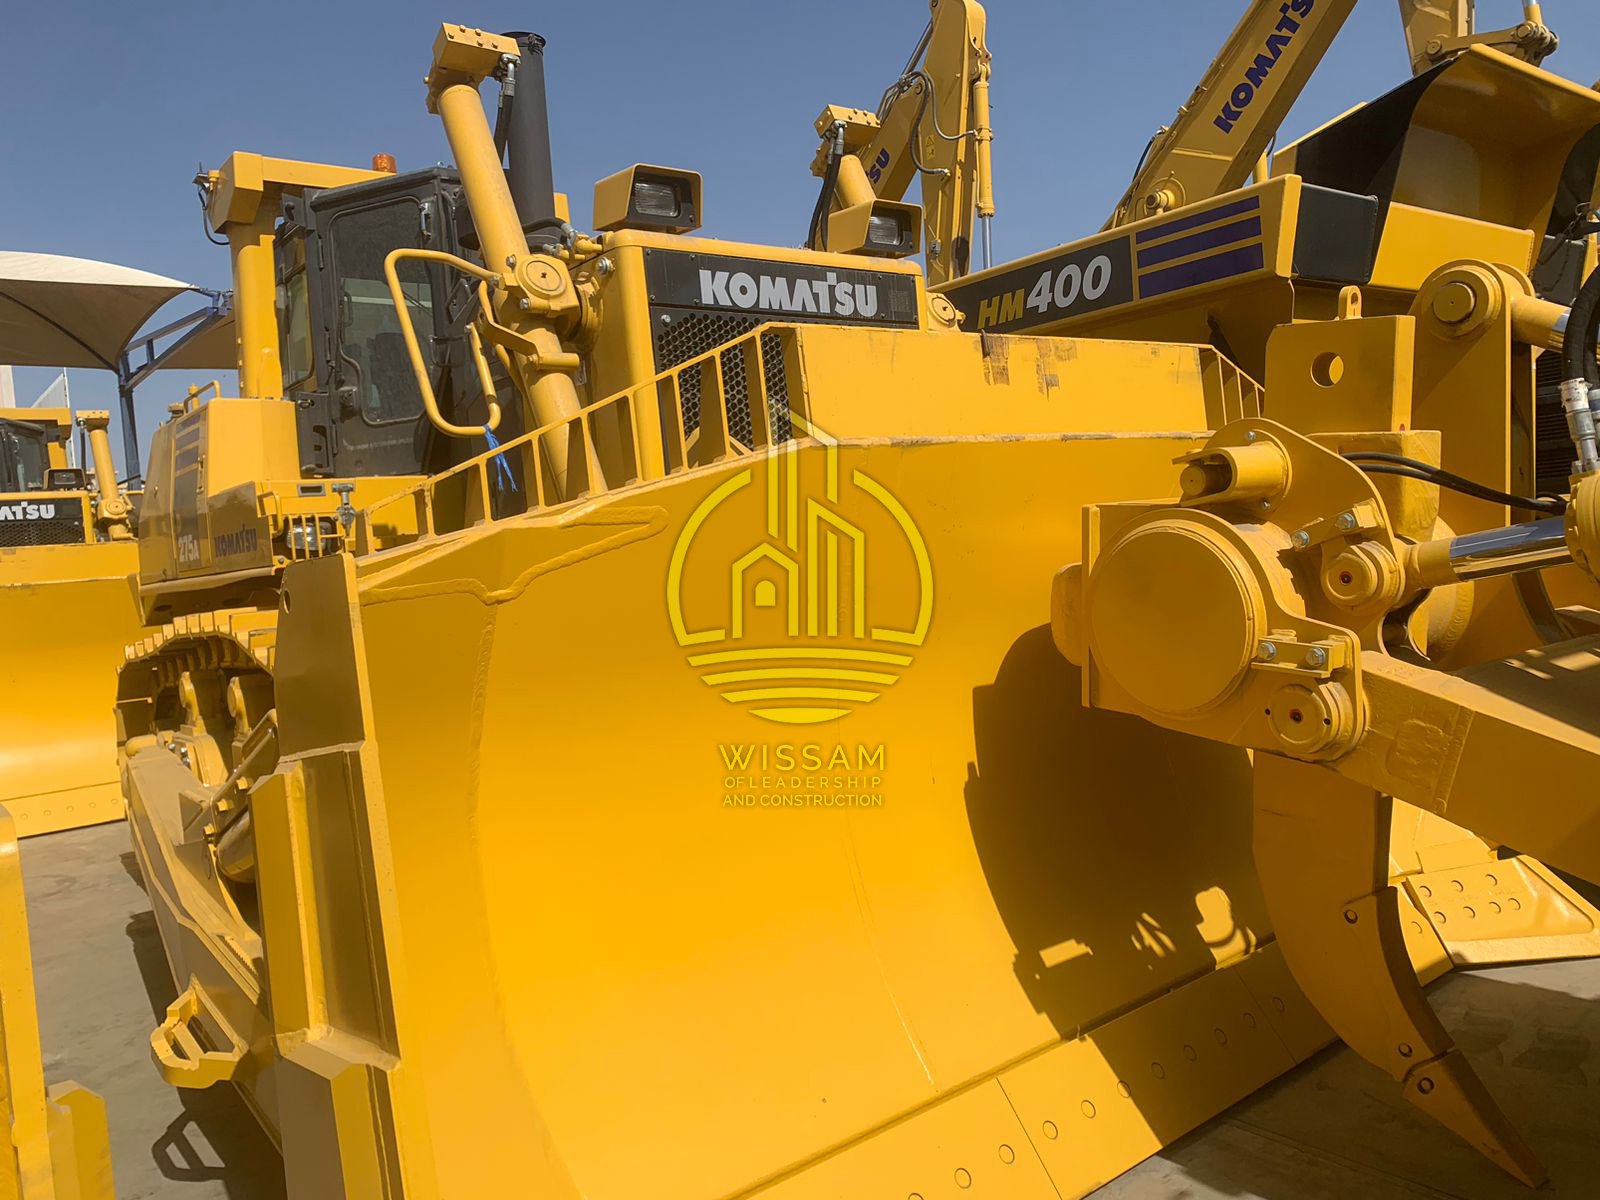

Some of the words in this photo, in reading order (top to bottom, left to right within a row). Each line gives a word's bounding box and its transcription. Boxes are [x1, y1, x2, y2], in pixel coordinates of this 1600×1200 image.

[867, 147, 890, 184] SU
[699, 269, 878, 317] KOMATSU
[178, 534, 200, 562] 275A
[214, 523, 258, 558] KOMATSU
